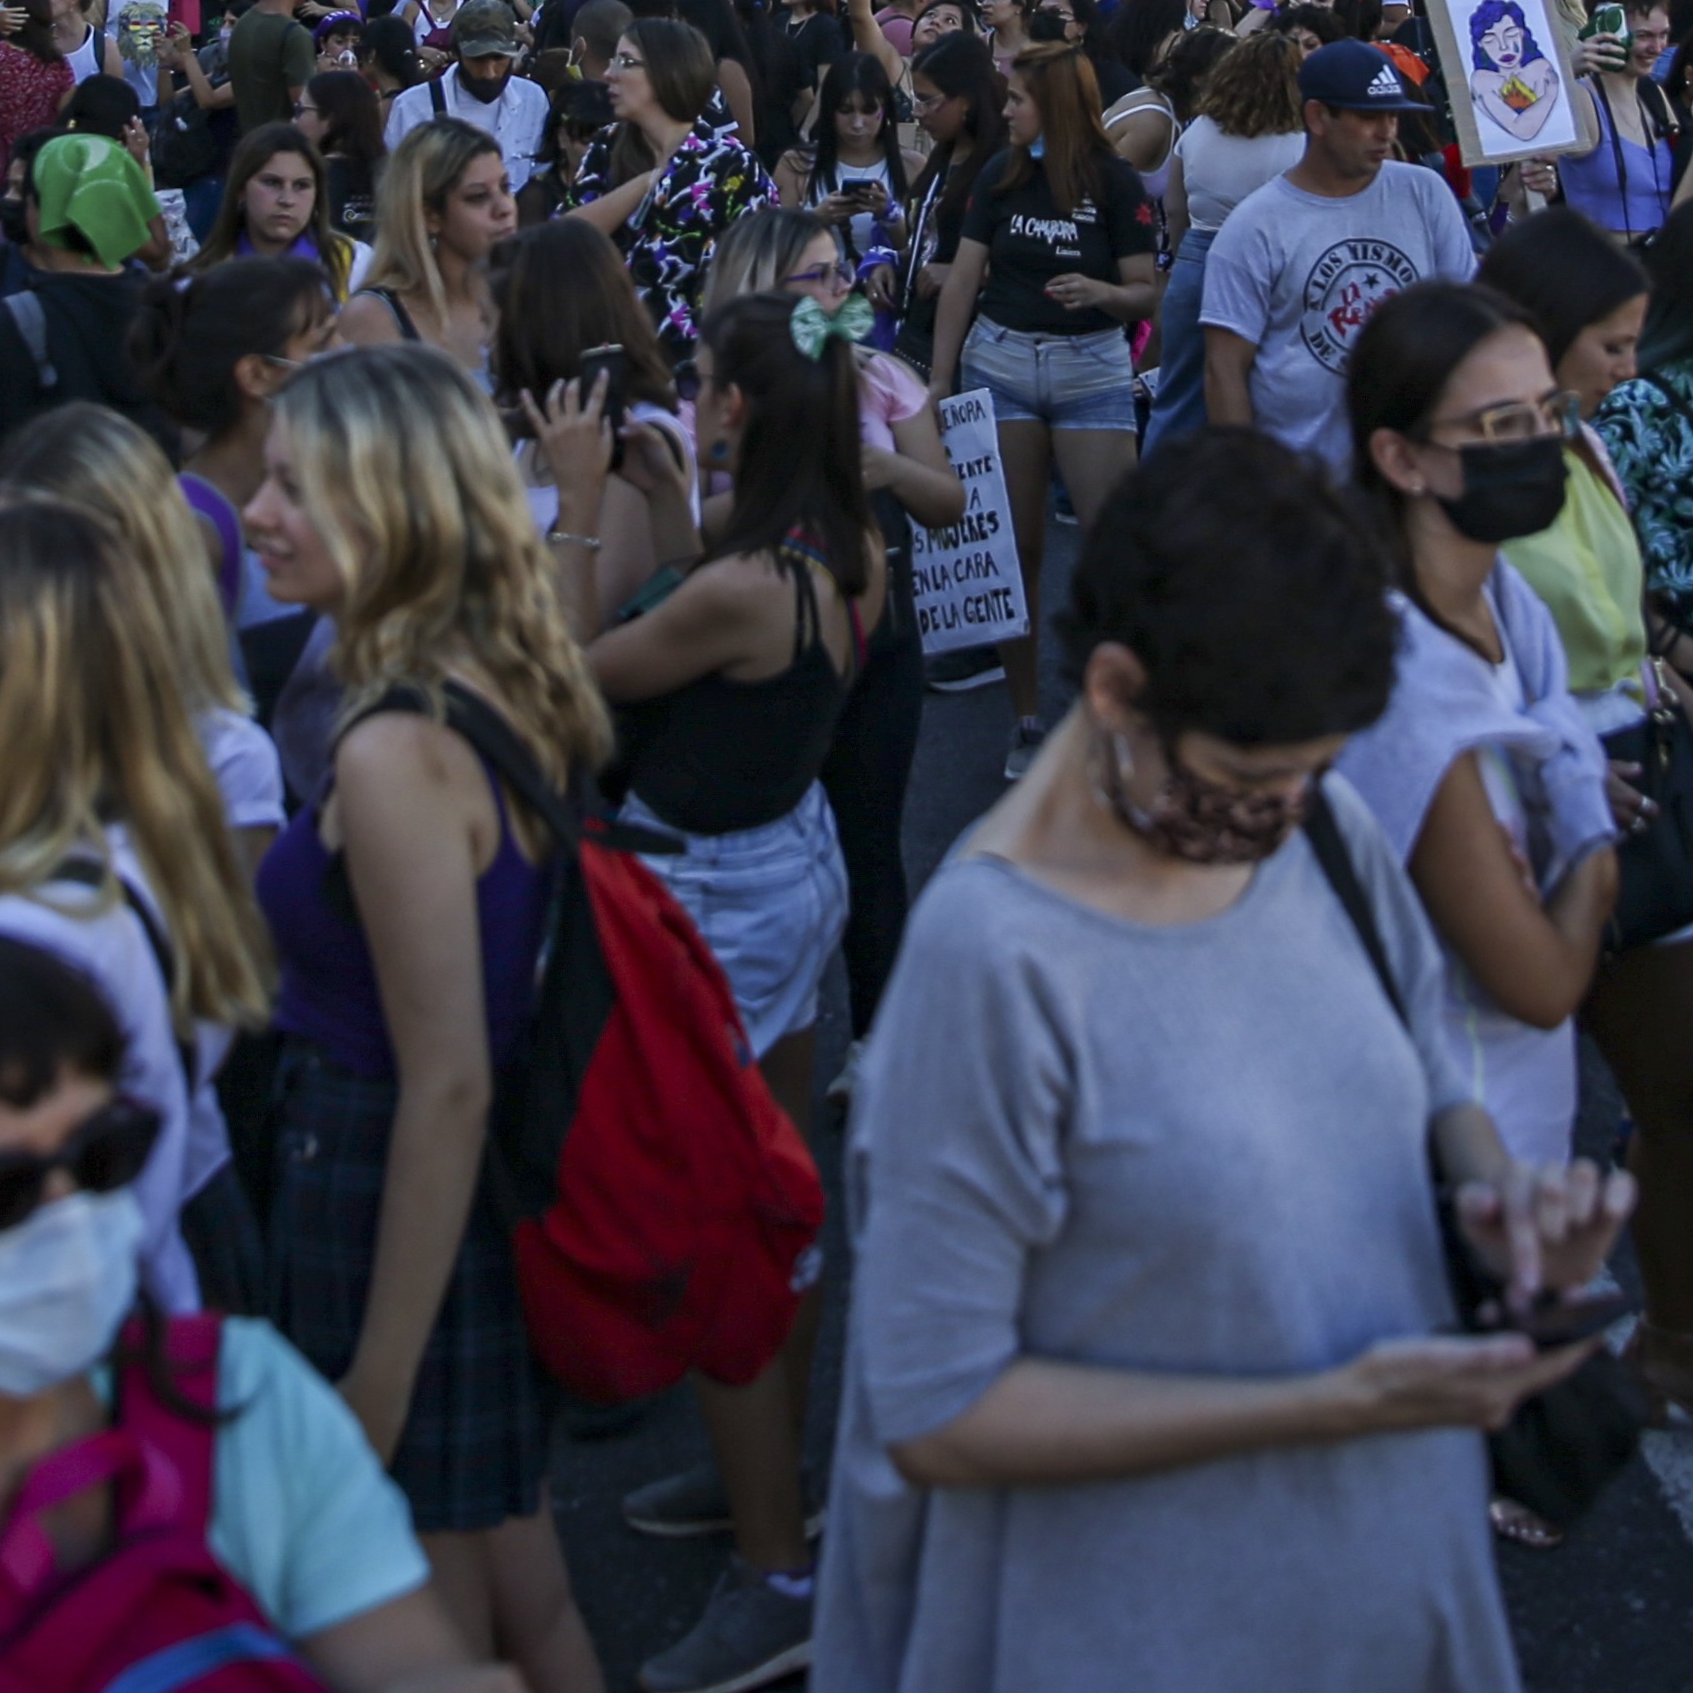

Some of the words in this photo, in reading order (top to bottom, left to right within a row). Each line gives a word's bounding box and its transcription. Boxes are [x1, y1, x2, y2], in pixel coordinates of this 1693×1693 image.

[1368, 84, 1401, 96] adidas
[1010, 214, 1023, 235] LA
[1312, 252, 1343, 290] LOS
[1309, 331, 1337, 361] DE
[942, 399, 987, 430] EÑORA
[952, 456, 994, 481] ENTE
[970, 487, 981, 509] A
[933, 564, 952, 591] LA
[953, 550, 999, 583] CARA
[919, 604, 940, 635] DE
[943, 600, 961, 630] LA
[963, 587, 1016, 624] GENTE
